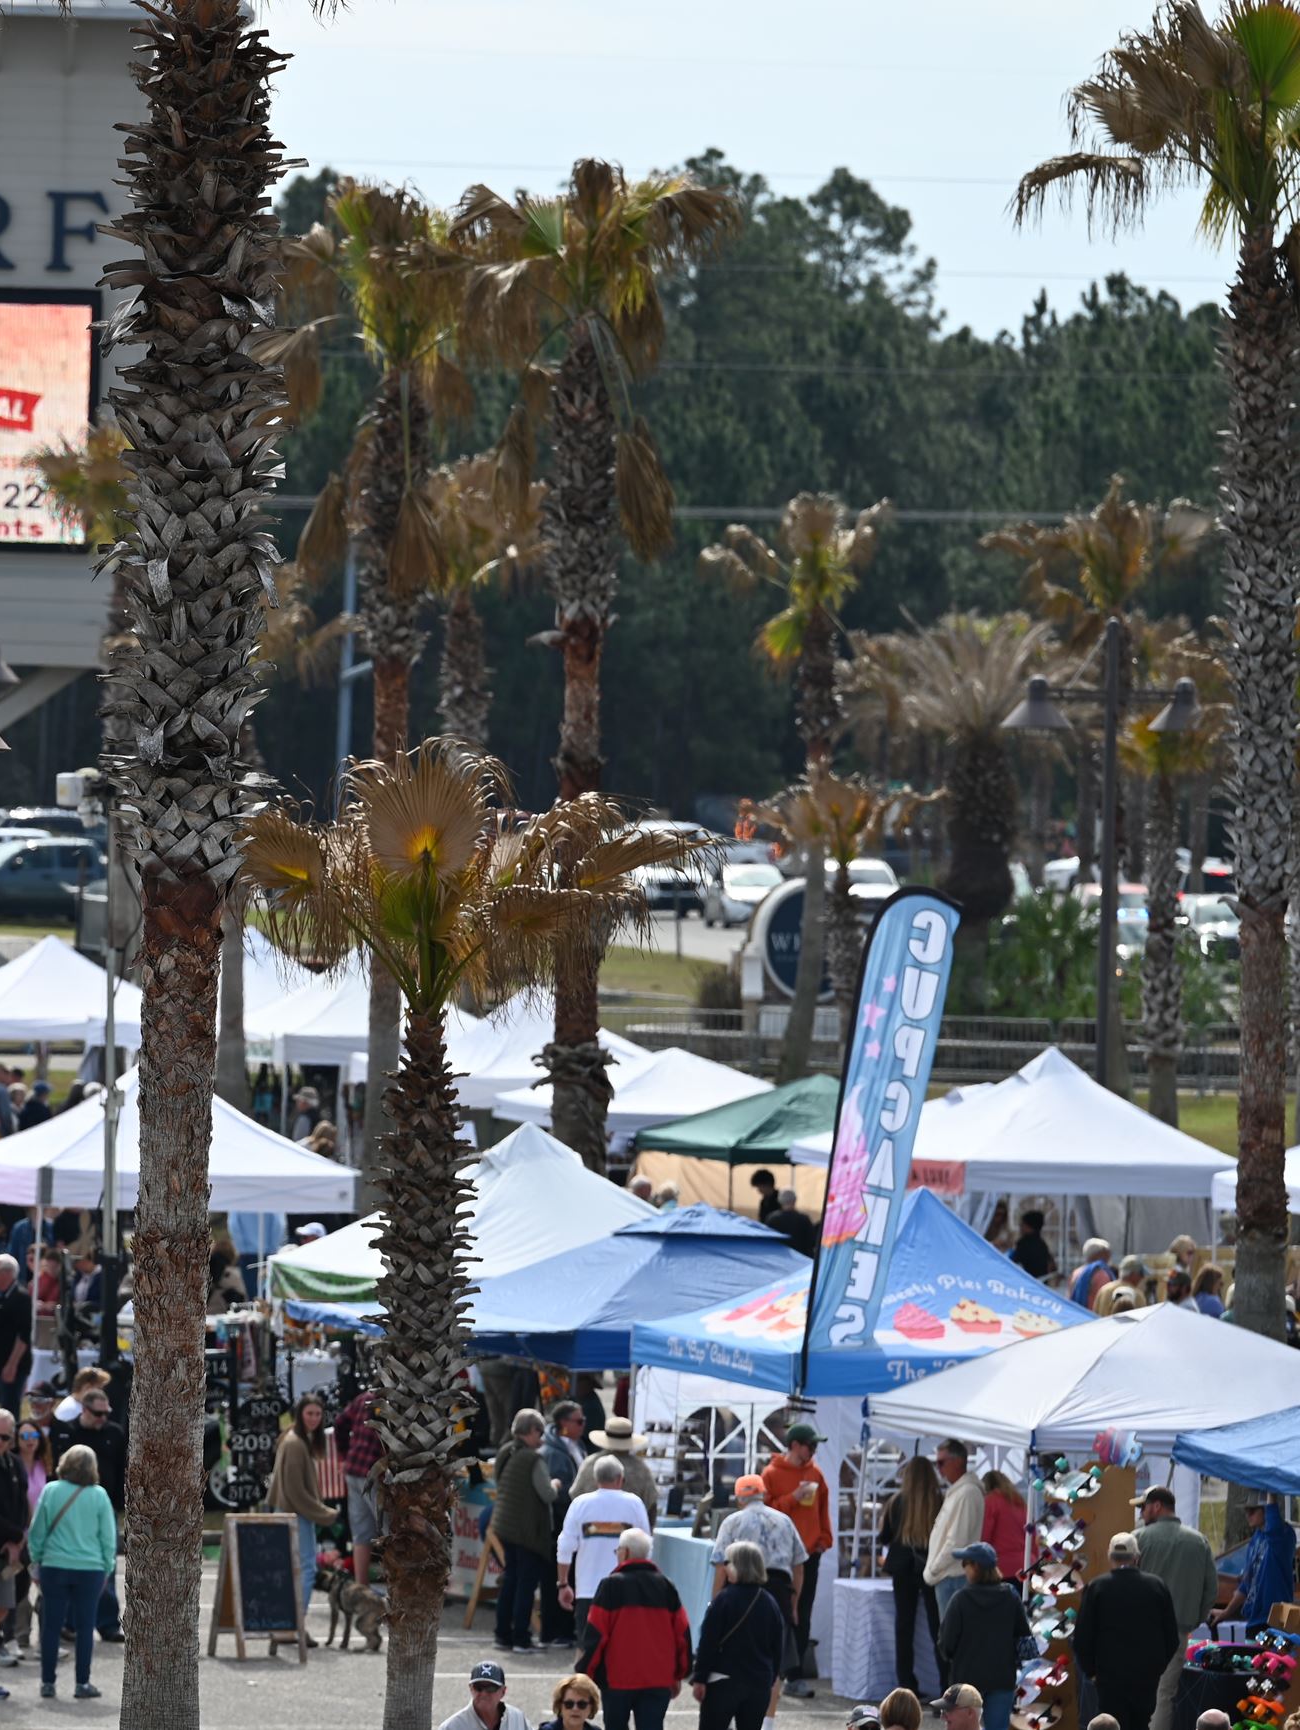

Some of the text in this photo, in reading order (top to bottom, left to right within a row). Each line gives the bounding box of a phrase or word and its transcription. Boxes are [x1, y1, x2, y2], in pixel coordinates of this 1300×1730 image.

[3, 483, 45, 508] 22
[881, 1282, 937, 1309] weety
[986, 1278, 1064, 1315] Bakery
[886, 1359, 928, 1382] The
[231, 1433, 273, 1451] 209
